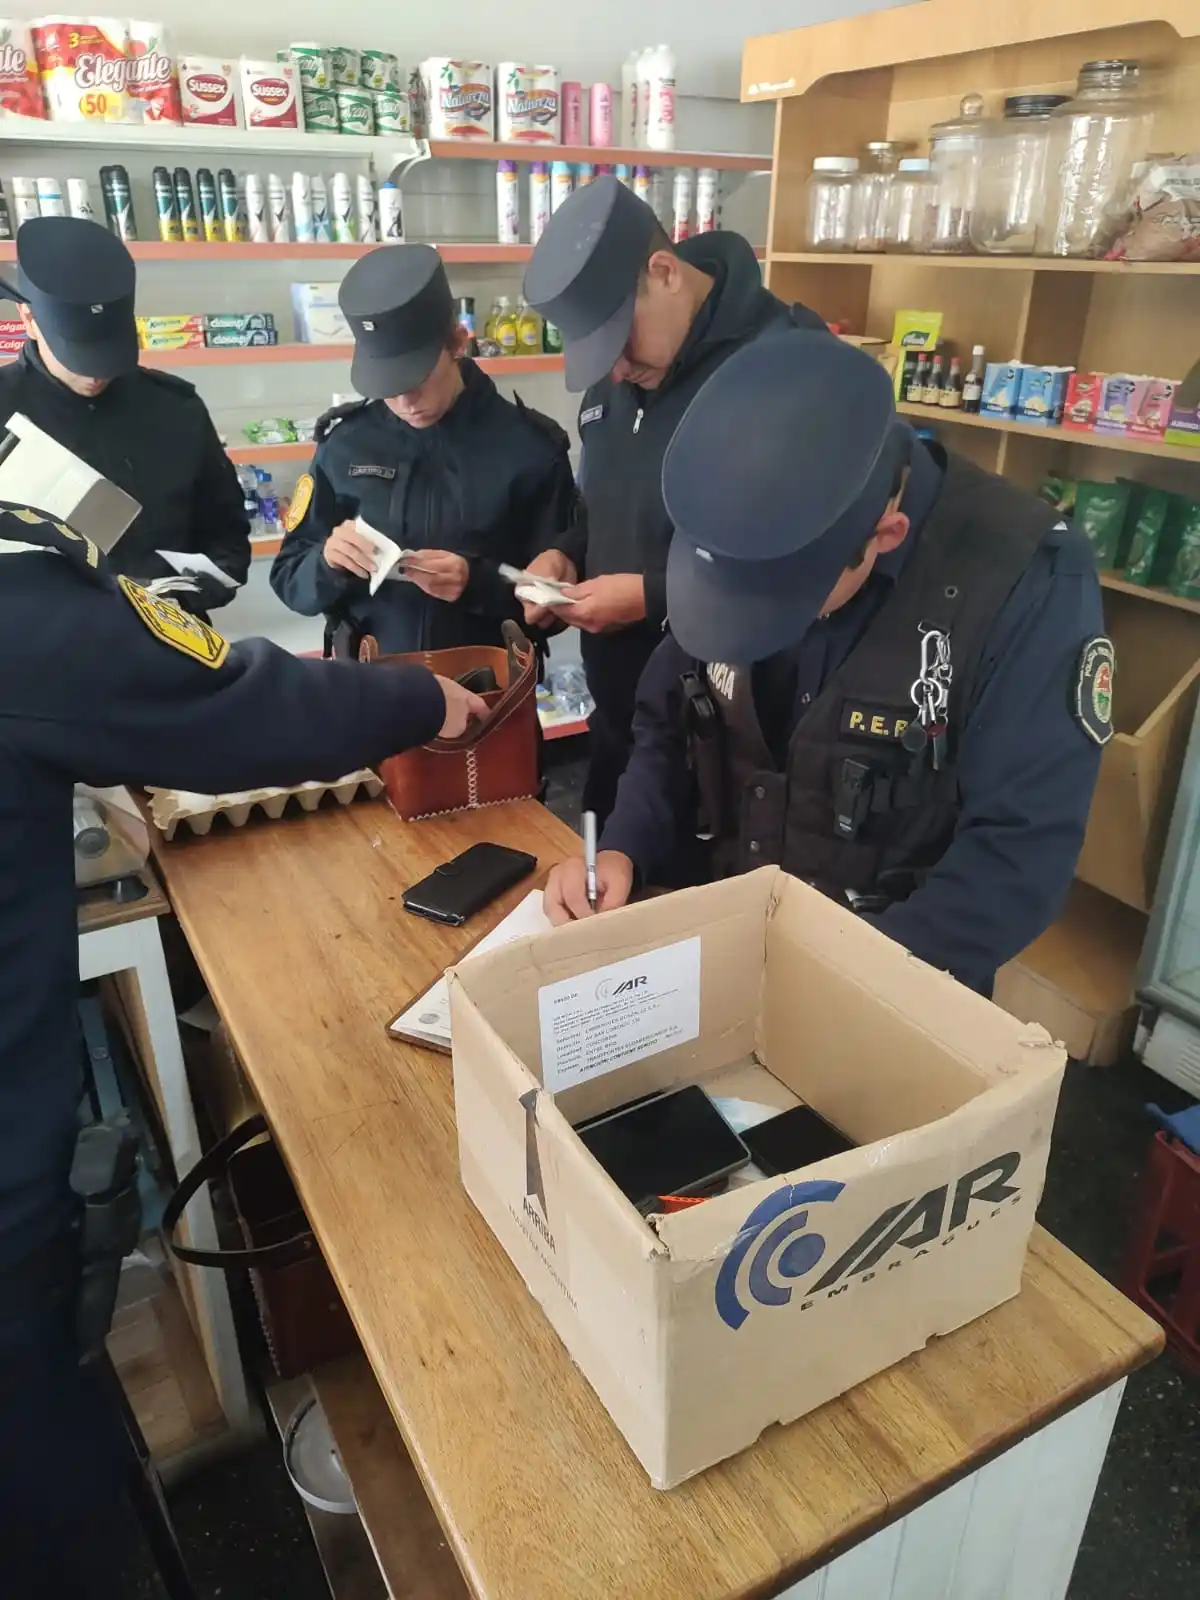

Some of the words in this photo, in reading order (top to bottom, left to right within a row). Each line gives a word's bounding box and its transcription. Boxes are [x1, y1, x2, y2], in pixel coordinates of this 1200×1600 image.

[75, 51, 172, 92] Elegante
[189, 80, 226, 94] Sussex
[84, 94, 108, 115] 50
[251, 83, 289, 98] Sussex
[523, 1196, 556, 1255] ARRIBA
[801, 1195, 1022, 1311] EMBRAGUES
